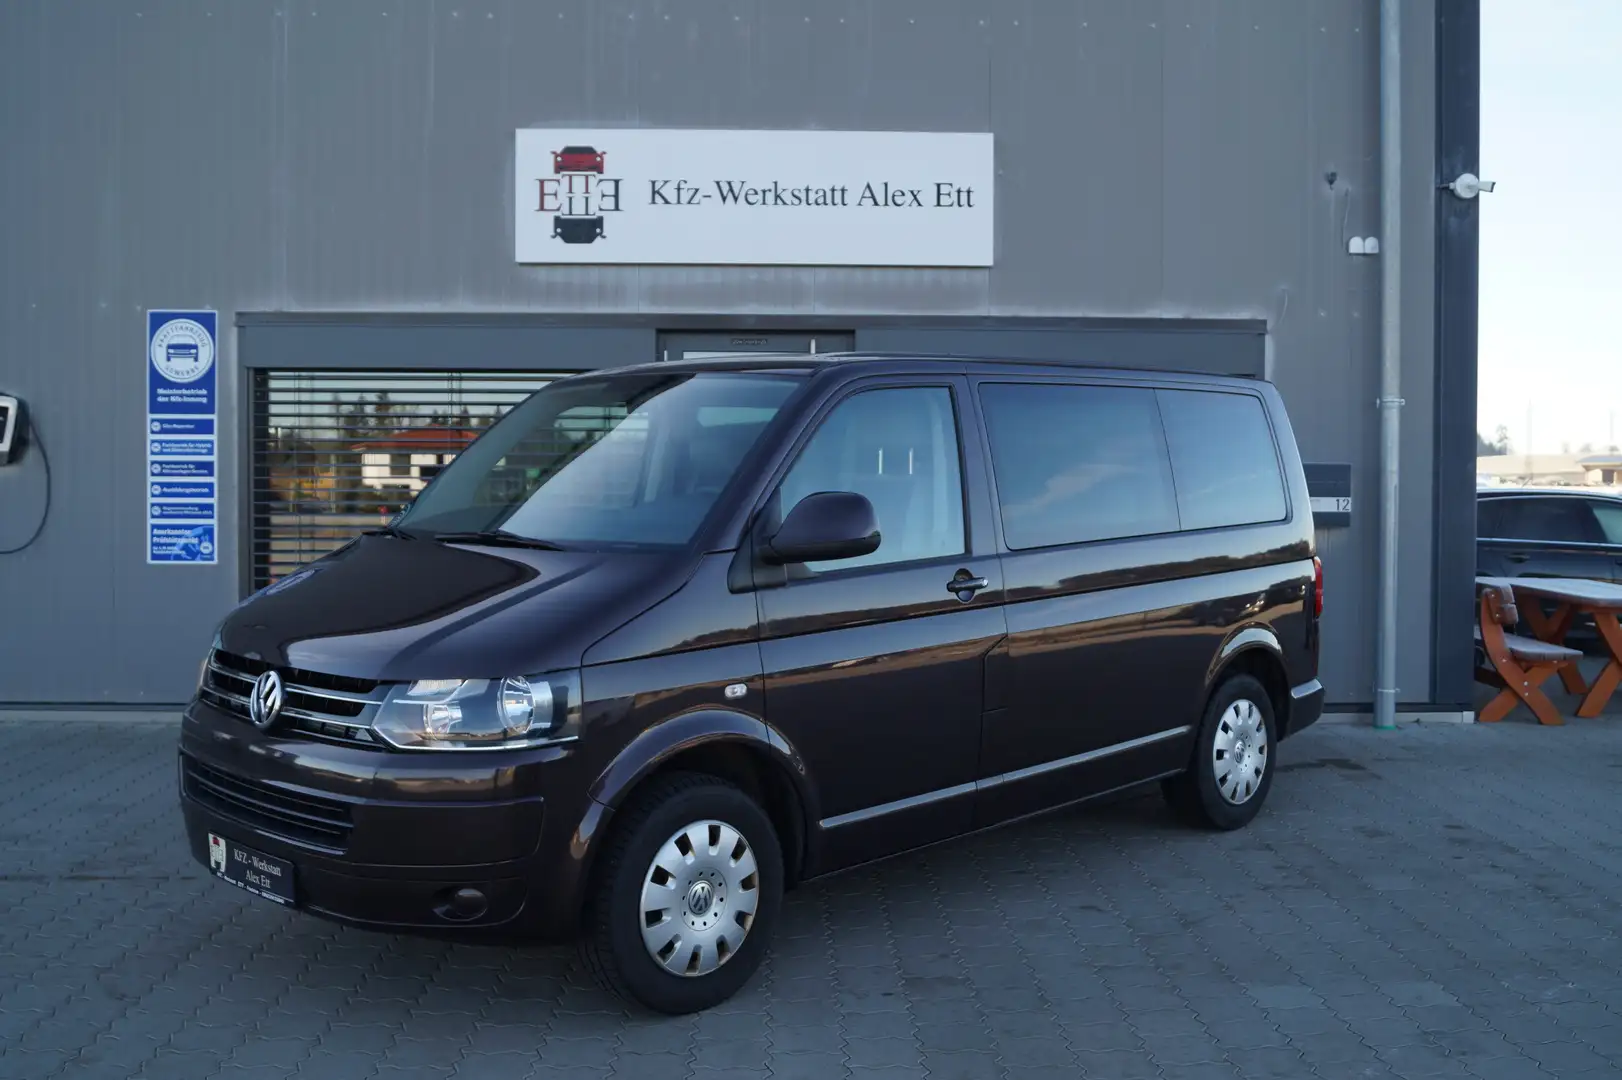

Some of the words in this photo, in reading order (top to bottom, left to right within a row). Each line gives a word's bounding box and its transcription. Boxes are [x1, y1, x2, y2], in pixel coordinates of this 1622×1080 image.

[648, 179, 849, 207] Kfz-Werkstatt
[856, 181, 923, 208] Alex
[933, 182, 976, 208] Ett
[1335, 498, 1351, 511] 12
[245, 869, 261, 885] Alex
